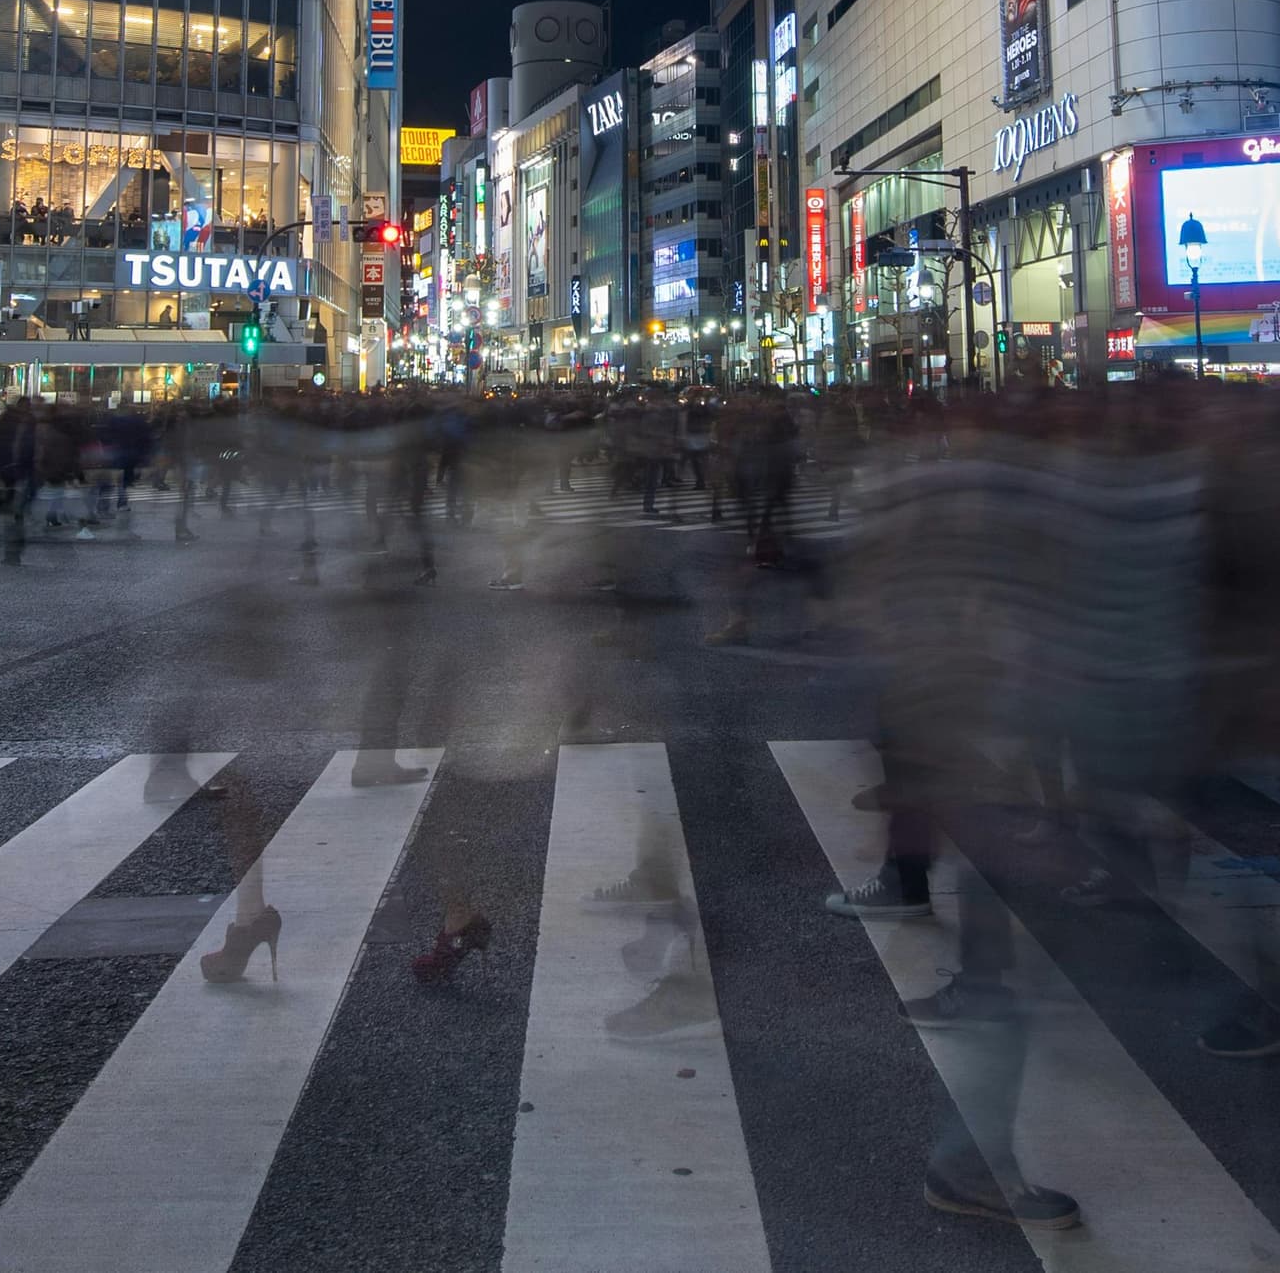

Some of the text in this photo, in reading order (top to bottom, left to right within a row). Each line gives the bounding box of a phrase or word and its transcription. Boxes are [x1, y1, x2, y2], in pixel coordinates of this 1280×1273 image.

[1006, 29, 1037, 63] HEROES
[587, 90, 624, 137] ZARA
[402, 131, 439, 145] TOWER
[125, 253, 294, 292] TSUTAYA
[366, 265, 383, 281] 本
[572, 280, 581, 314] ZARA
[1023, 323, 1052, 336] MARVEL
